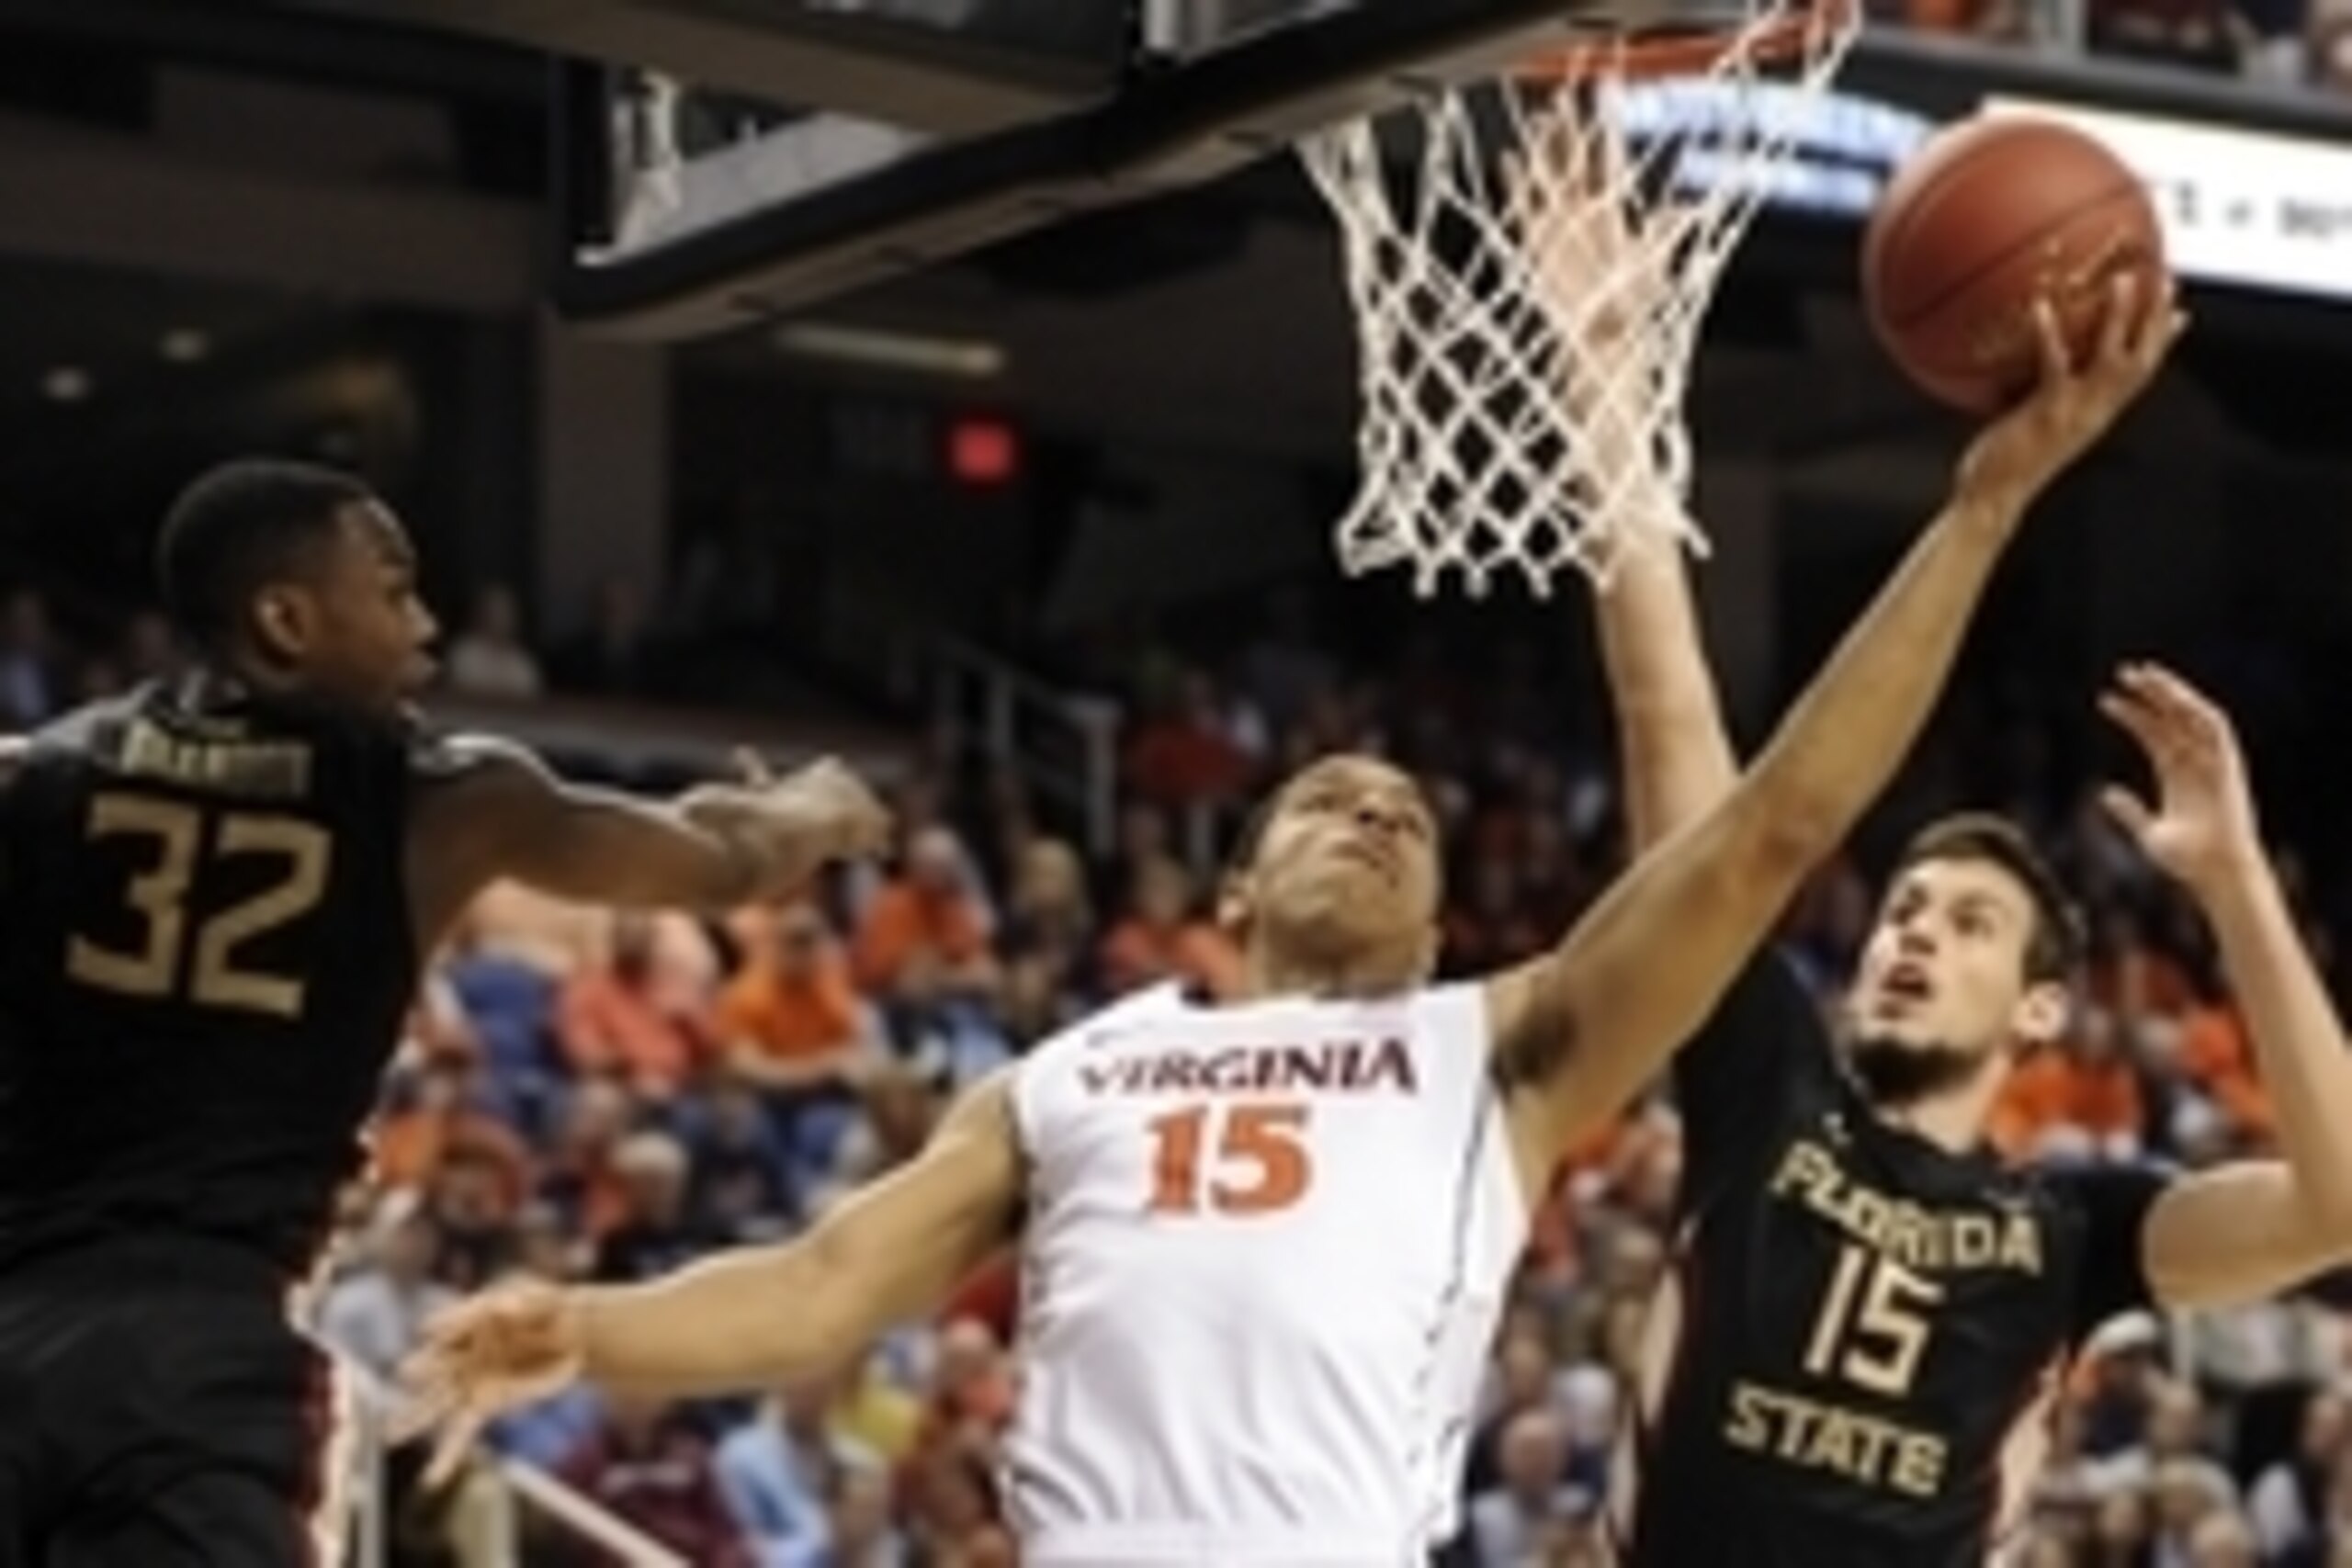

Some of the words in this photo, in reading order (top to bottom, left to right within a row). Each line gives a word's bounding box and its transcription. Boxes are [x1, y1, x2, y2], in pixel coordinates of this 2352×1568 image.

[66, 794, 332, 1018] 32
[1080, 1037, 1418, 1094] VIRGINIA
[1145, 1104, 1312, 1217] 15
[1770, 1140, 2042, 1276] FLORIDA
[1804, 1245, 1944, 1394] 15
[1723, 1385, 1949, 1496] STATE
